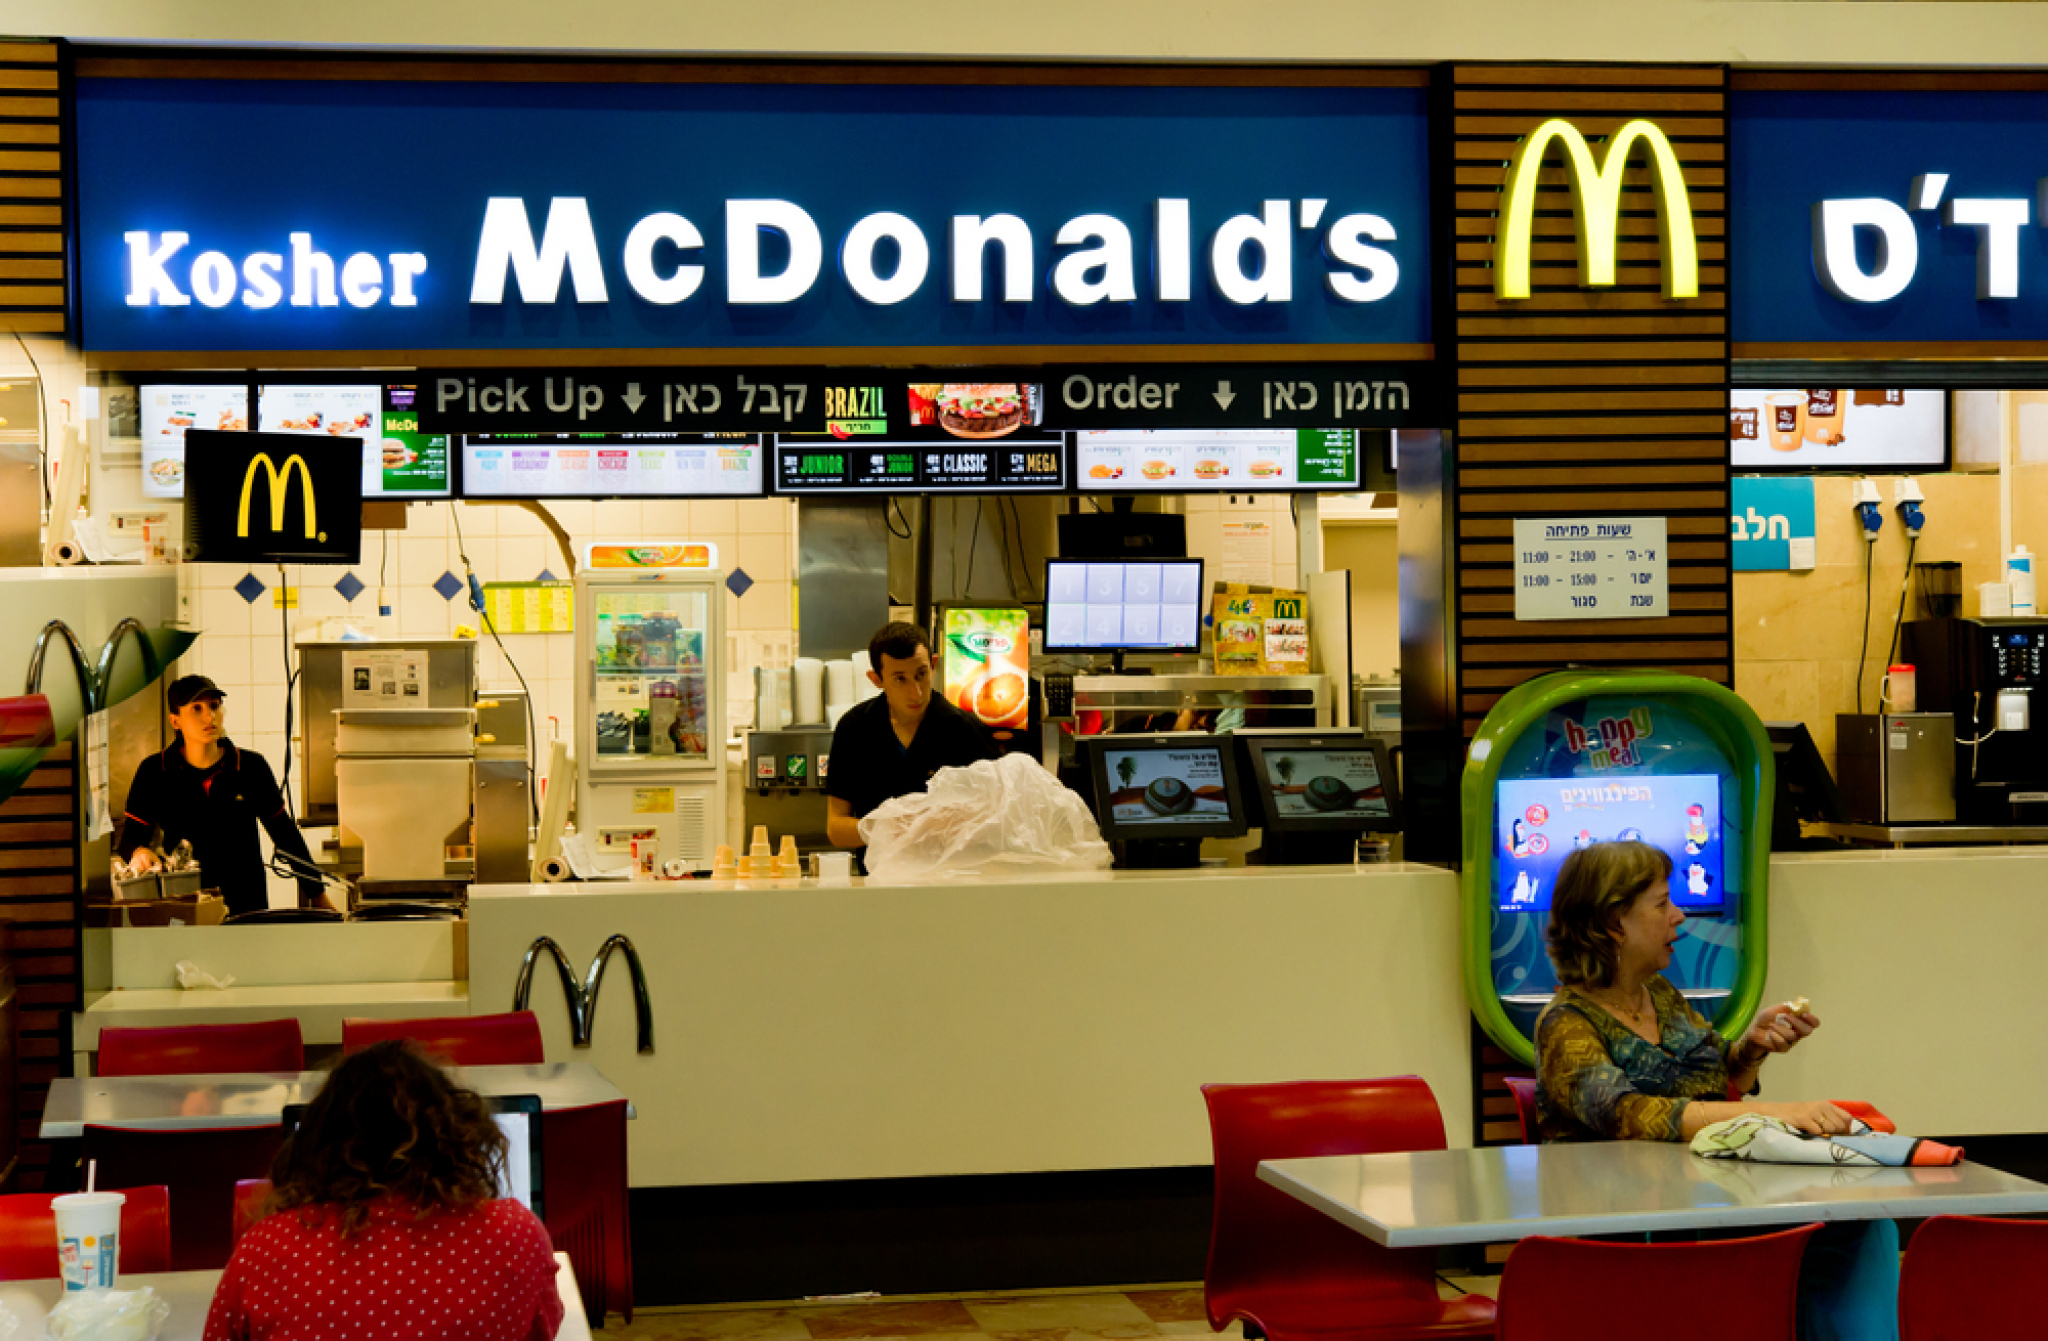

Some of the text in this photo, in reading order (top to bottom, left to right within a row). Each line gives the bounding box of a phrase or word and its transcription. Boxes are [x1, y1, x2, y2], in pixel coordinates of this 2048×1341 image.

[1817, 173, 2048, 302] ד'ס
[124, 195, 1400, 309] Kosher McDonald's
[436, 376, 530, 413] Pick
[545, 376, 605, 421] Up
[662, 374, 807, 422] קבל כאן
[824, 386, 888, 418] BRAZIL
[1062, 374, 1180, 410] Order
[1263, 381, 1410, 419] הזמן כאן
[800, 453, 845, 474] JUNIOR
[943, 453, 988, 474] CLASSIC
[1025, 453, 1058, 474] MEGA
[1545, 523, 1632, 538] שעות פתיחה
[1522, 551, 1549, 563] 11:00
[1569, 550, 1597, 563] 21:00
[1522, 574, 1550, 587] 11:00
[1570, 573, 1598, 586] 15:00
[1570, 595, 1654, 608] שבת סגור
[1564, 706, 1652, 752] happy
[1590, 743, 1643, 769] meal
